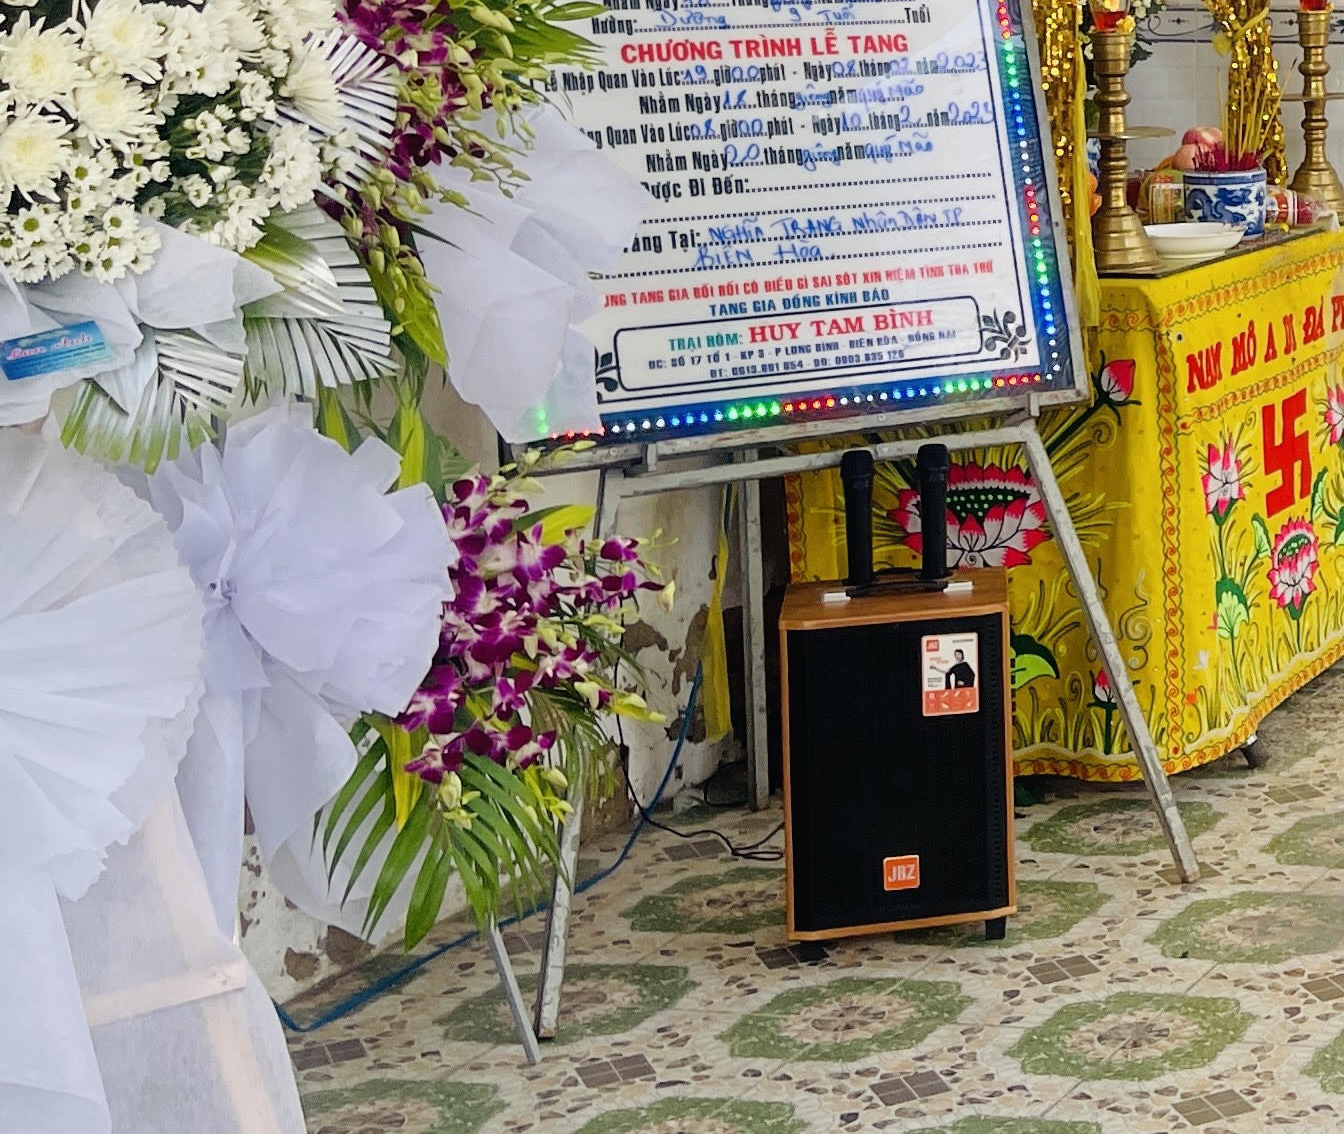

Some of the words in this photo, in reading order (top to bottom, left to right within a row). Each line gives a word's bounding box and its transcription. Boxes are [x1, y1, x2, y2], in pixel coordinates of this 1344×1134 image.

[620, 36, 723, 64] CHƯƠNG
[728, 32, 801, 59] TRÌNH
[811, 27, 837, 56] LỄ
[847, 33, 908, 54] TANG
[562, 70, 594, 95] Nhập
[600, 72, 628, 92] Quan
[631, 68, 655, 88] Vào
[803, 61, 832, 82] Ngày
[606, 125, 637, 147] Quan
[640, 122, 665, 143] Vào
[632, 293, 664, 305] TANG
[668, 287, 690, 301] GIA
[812, 274, 832, 288] SAI
[863, 270, 882, 284] XIN
[709, 302, 748, 317] TANG
[752, 298, 776, 312] GIA
[862, 287, 890, 302] BÁO
[748, 322, 802, 344] HUY
[810, 315, 864, 337] TAM
[872, 308, 934, 331] BÌNH
